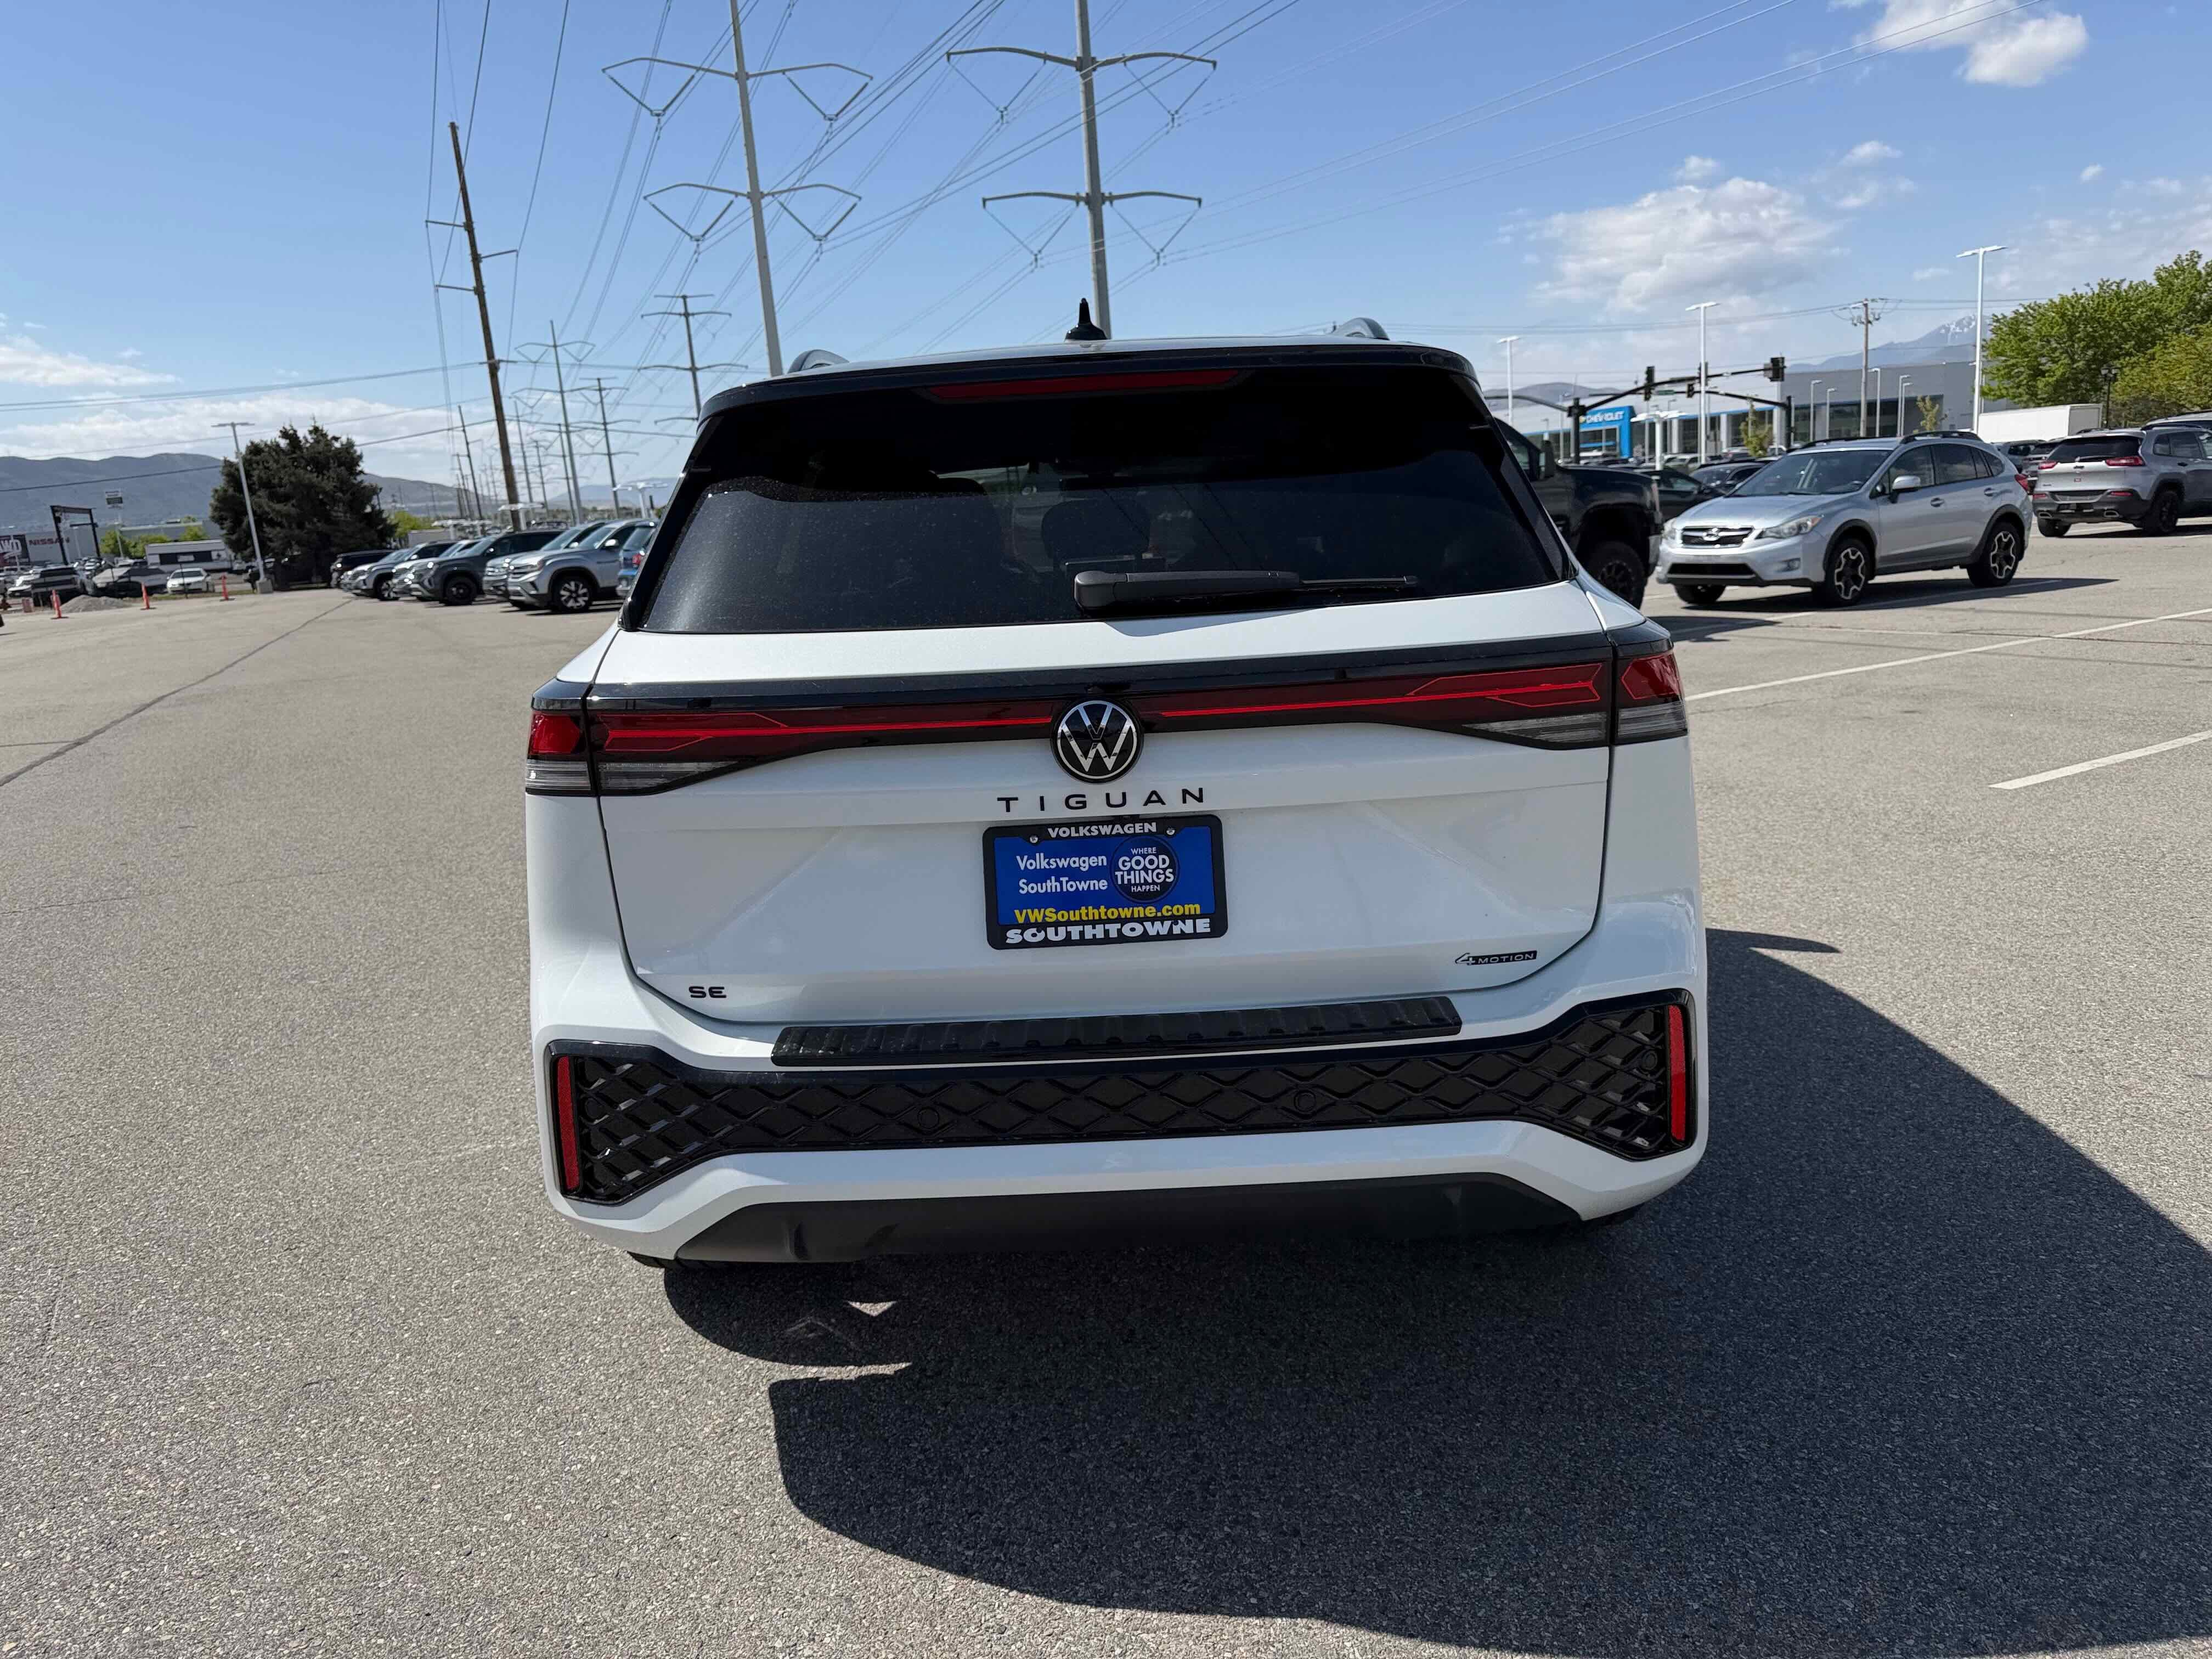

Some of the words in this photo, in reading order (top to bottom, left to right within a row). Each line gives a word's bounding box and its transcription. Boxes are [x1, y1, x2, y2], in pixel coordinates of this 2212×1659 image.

[1057, 700, 1137, 779] VW
[997, 787, 1204, 812] TIGUAN
[1047, 822, 1157, 839] VOLKSWAGEN
[1131, 847, 1156, 855] WHERE
[1016, 853, 1107, 872] Volkswagen
[1118, 855, 1170, 871] GOOD
[1018, 876, 1108, 894] SouthTowne
[1115, 869, 1175, 885] THINGS
[1131, 884, 1161, 893] HAPPEN
[1014, 904, 1201, 924] VWSouthtowne.com
[1005, 918, 1211, 944] SOUTHTOWNE
[1455, 952, 1534, 966] 4MOTION
[689, 986, 727, 998] SE
